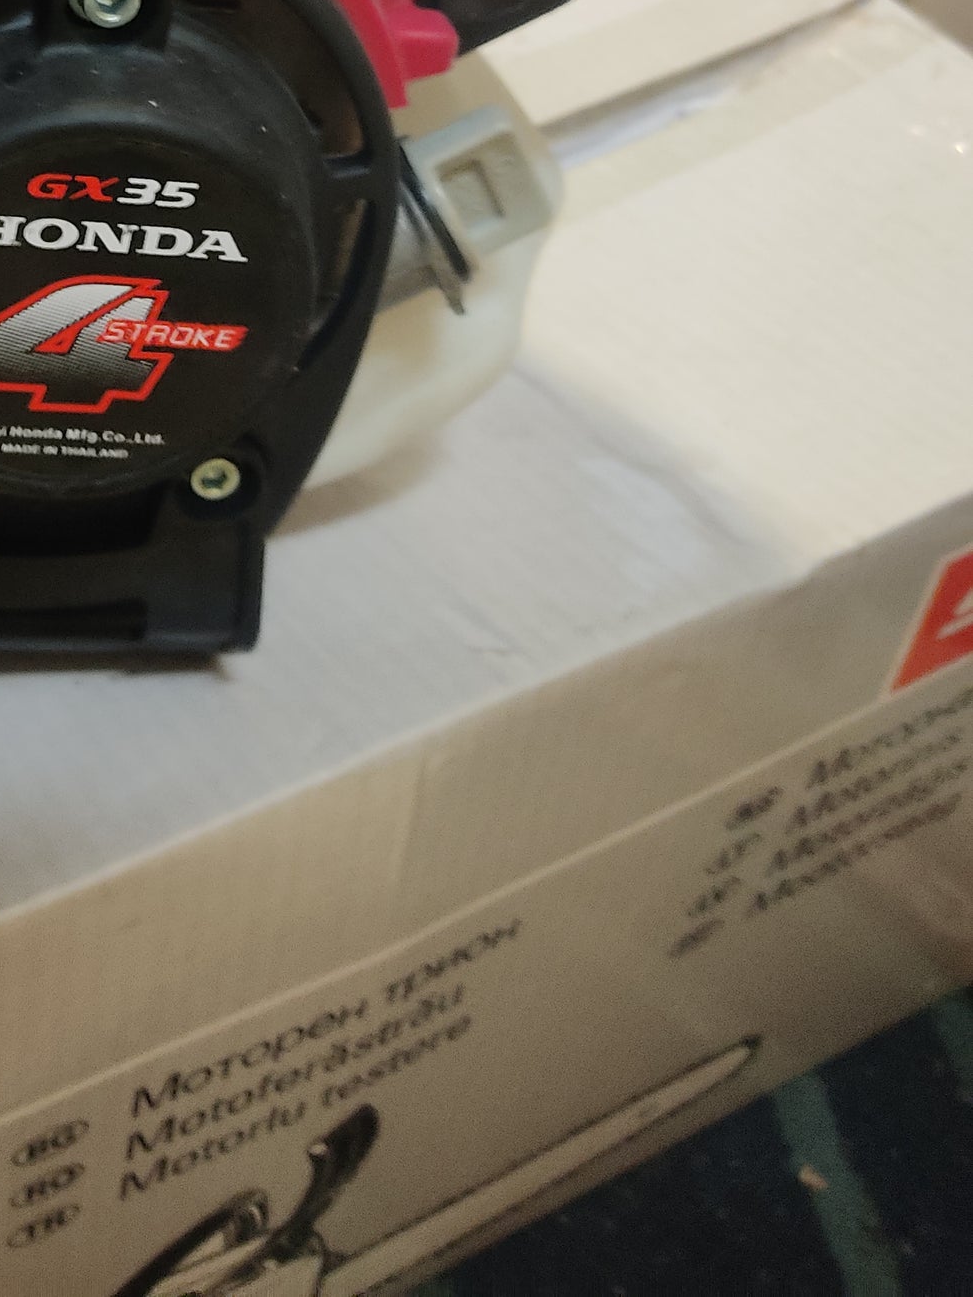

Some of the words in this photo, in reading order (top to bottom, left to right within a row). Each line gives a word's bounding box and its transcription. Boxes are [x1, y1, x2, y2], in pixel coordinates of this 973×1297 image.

[101, 321, 237, 349] STROKE
[9, 425, 63, 440] Honda
[1, 443, 41, 454] MADE
